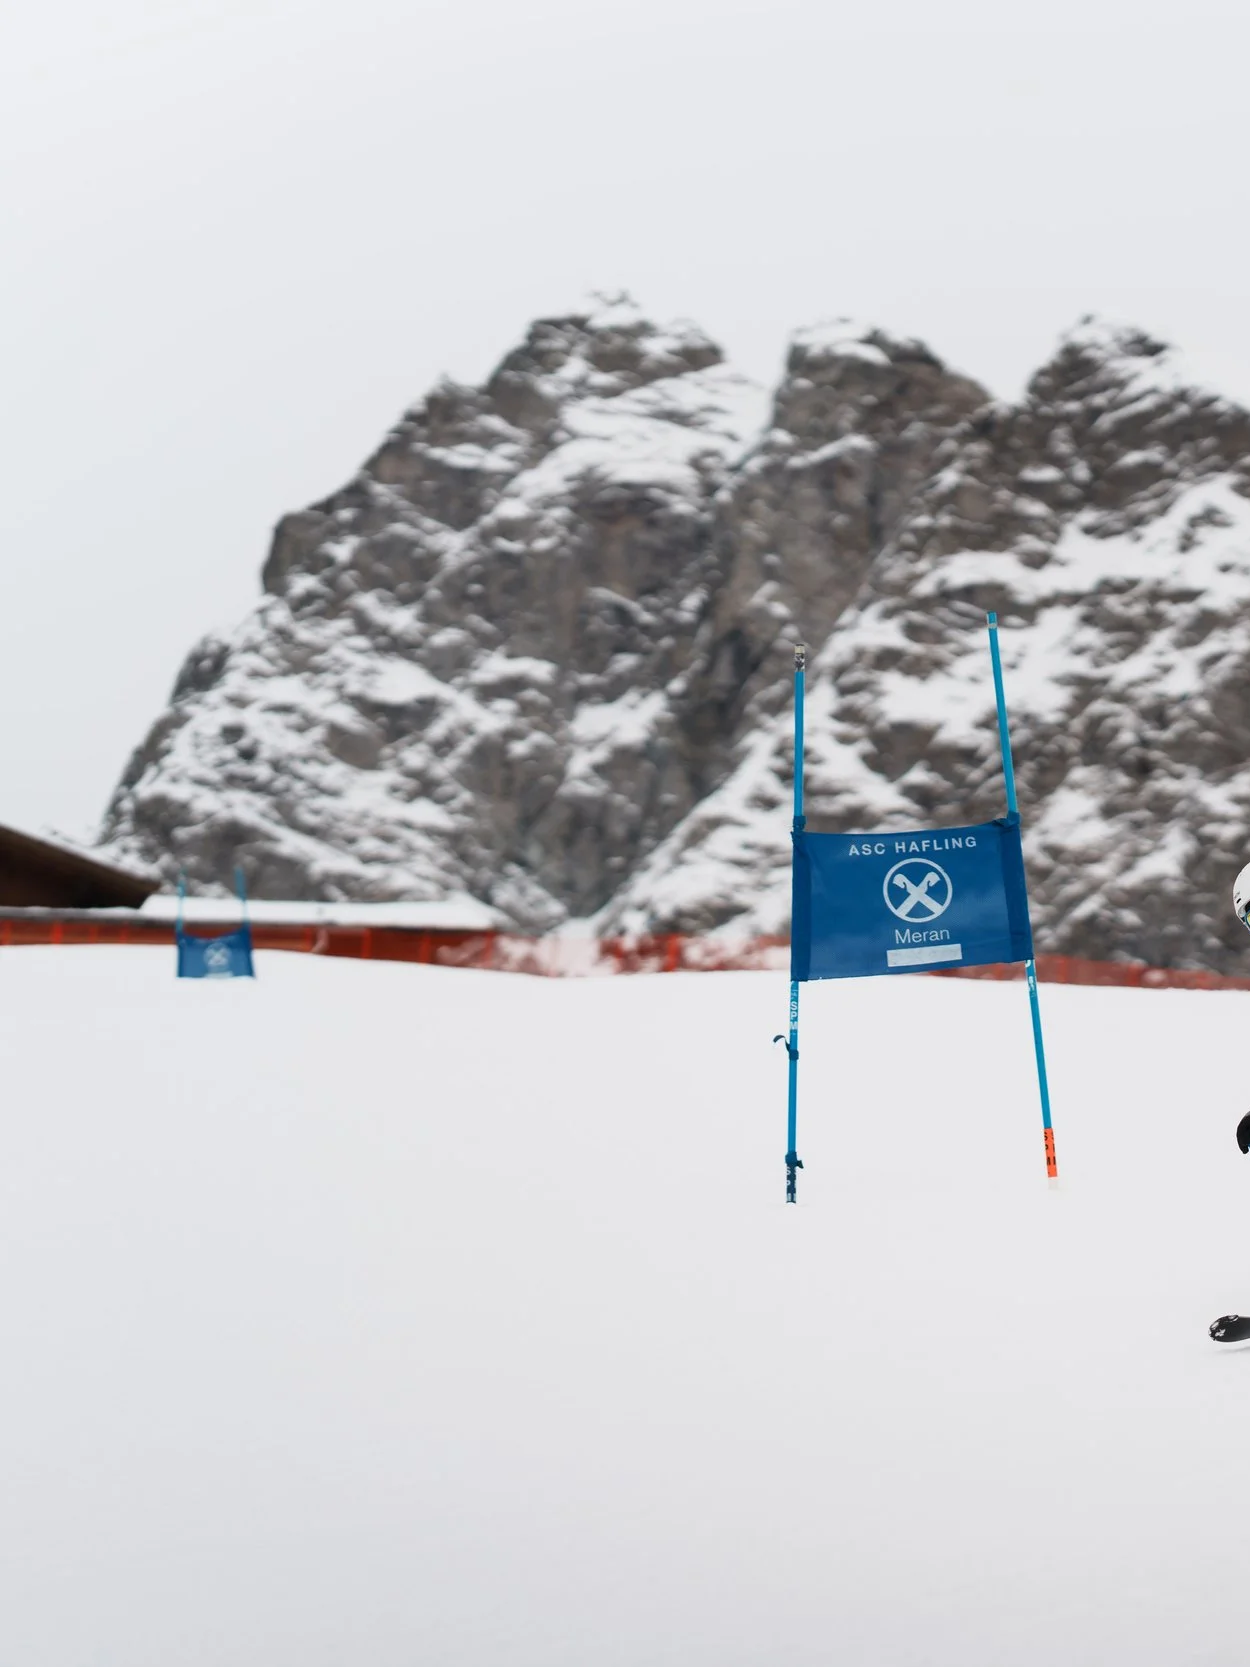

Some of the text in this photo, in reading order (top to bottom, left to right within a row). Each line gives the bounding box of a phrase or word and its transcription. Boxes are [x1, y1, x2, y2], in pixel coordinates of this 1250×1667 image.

[848, 836, 977, 856] ASC HAFLING
[895, 929, 950, 944] Meran
